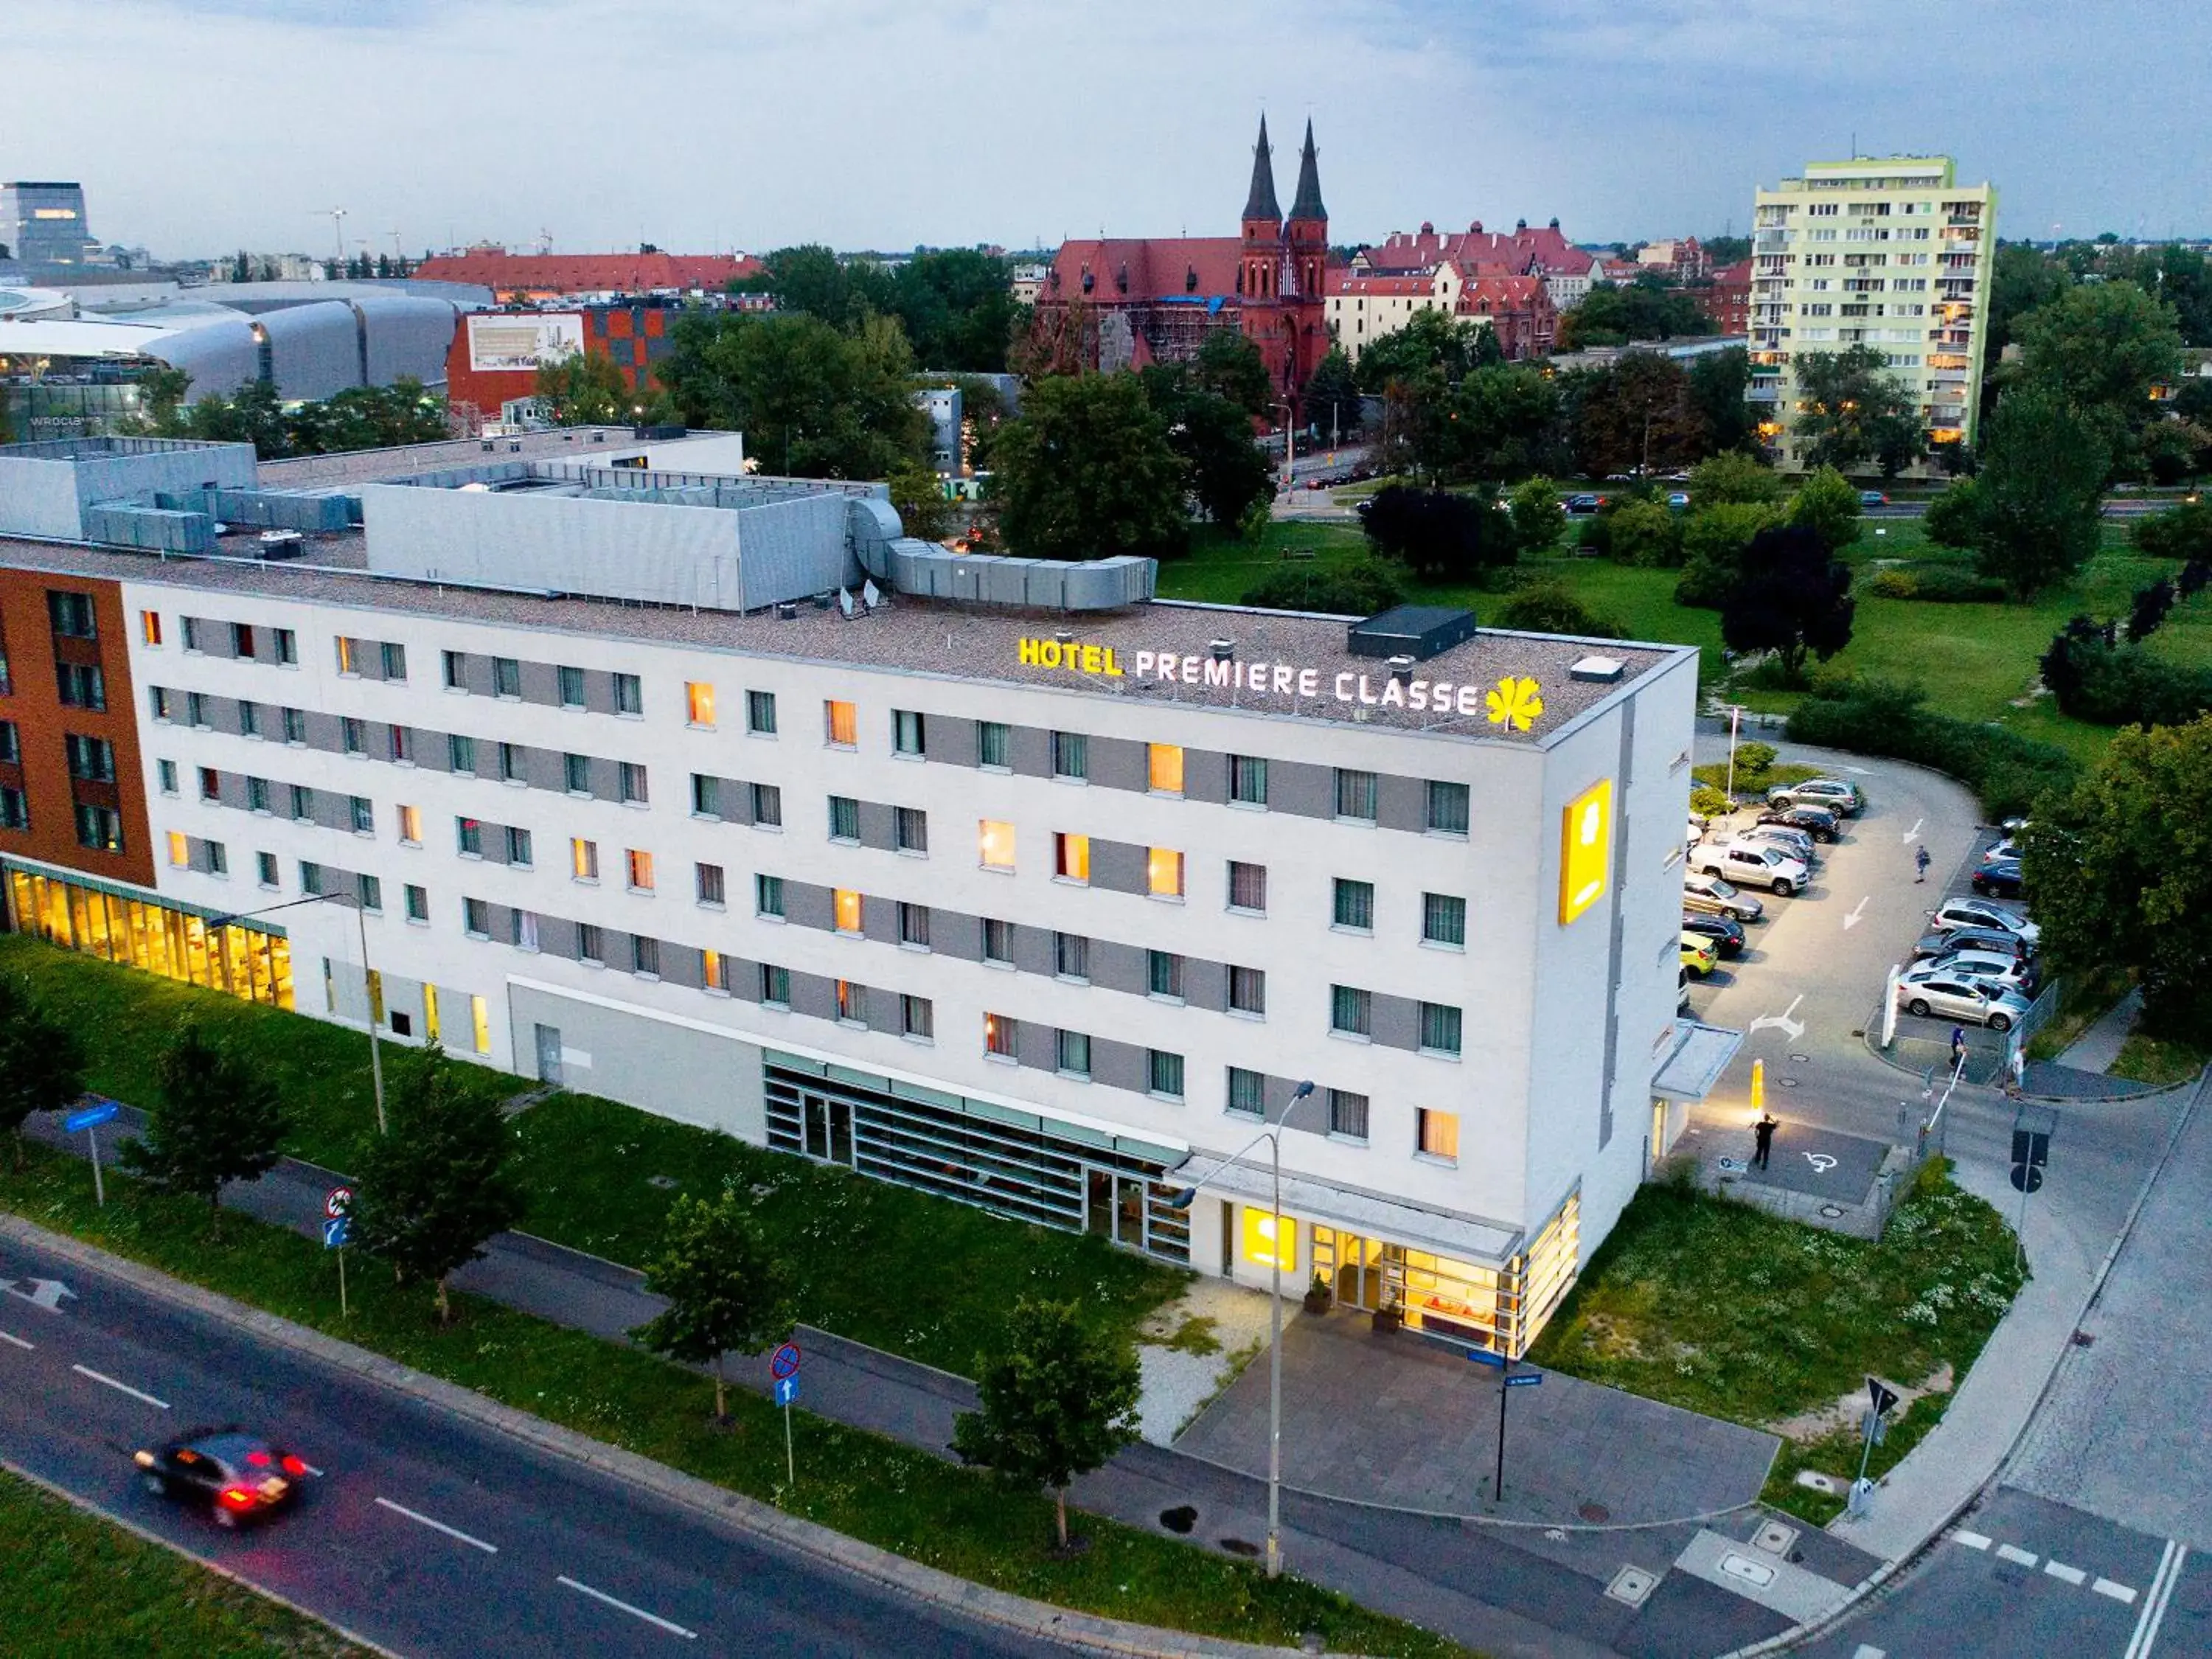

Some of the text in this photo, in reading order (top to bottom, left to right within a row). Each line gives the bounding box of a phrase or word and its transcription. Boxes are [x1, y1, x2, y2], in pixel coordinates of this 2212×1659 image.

[1019, 637, 1478, 716] HOTEL PREMIERE CLASSE
